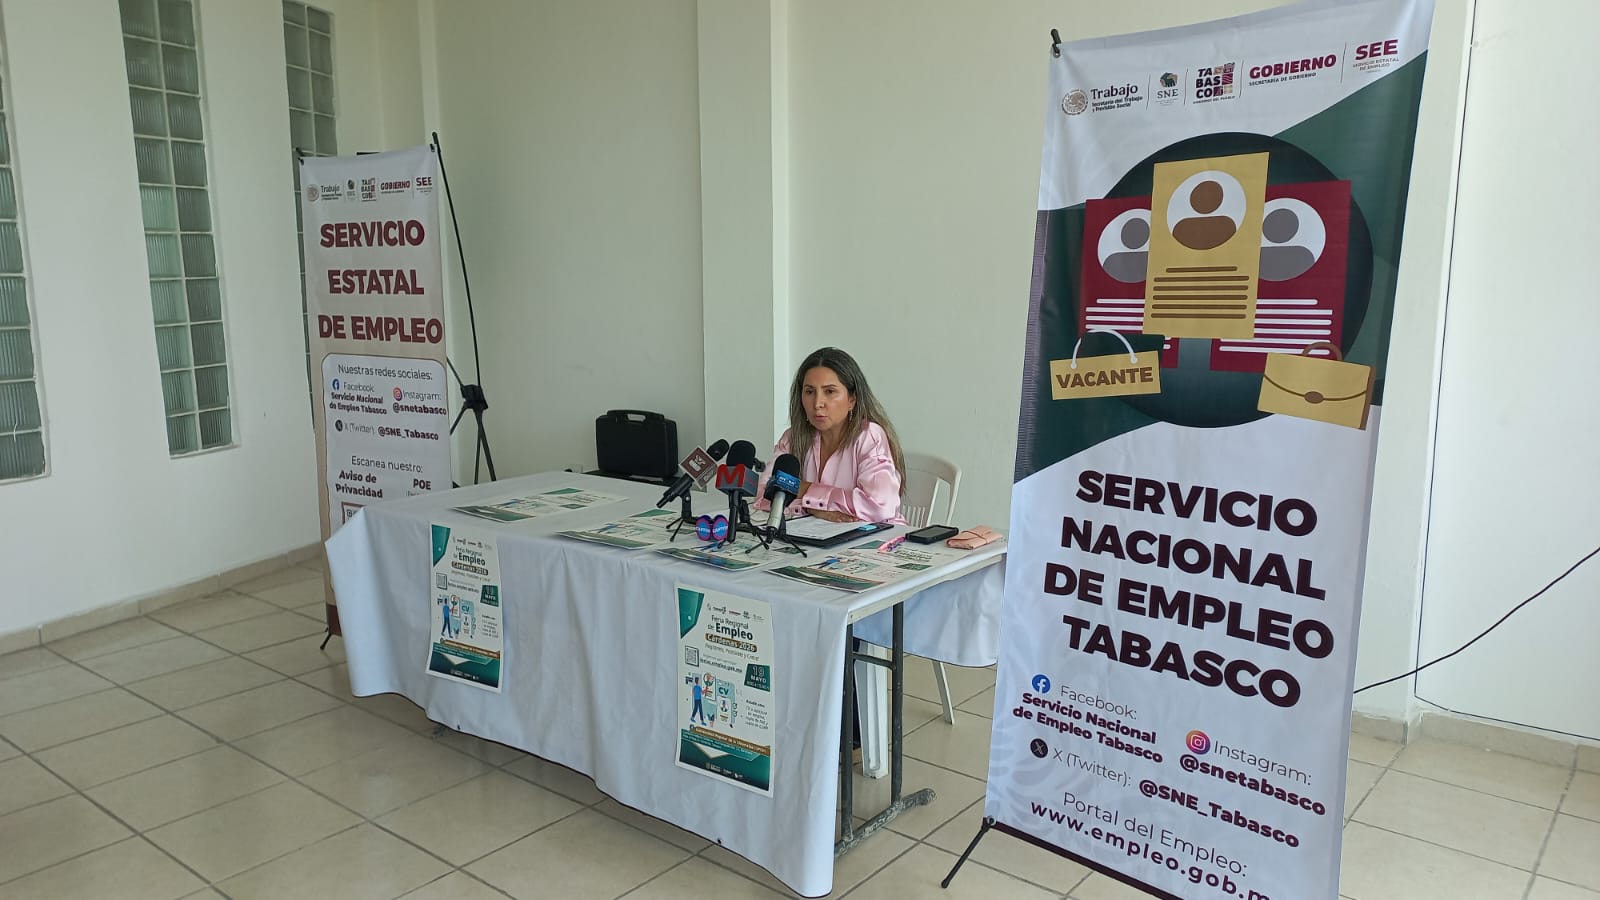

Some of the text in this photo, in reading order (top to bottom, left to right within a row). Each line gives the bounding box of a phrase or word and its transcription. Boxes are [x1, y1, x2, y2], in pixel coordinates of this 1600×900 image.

[1355, 39, 1398, 60] SEE
[1198, 67, 1212, 77] TA
[1249, 54, 1337, 79] GOBIERNO
[1289, 72, 1317, 80] GOBIERNO
[1090, 83, 1138, 100] Trabajo
[1196, 75, 1221, 88] BAS
[1157, 89, 1178, 99] SNE
[1196, 88, 1213, 98] CO
[380, 180, 411, 191] GOBIERNO
[416, 176, 432, 187] SEE
[320, 220, 425, 248] SERVICIO
[327, 269, 425, 295] ESTATAL
[318, 314, 443, 344] DE EMPLEO
[338, 364, 433, 380] Nuestras redes sociales:
[1056, 366, 1153, 389] VACANTE
[329, 402, 388, 415] de Empleo Tabasco
[331, 391, 447, 415] Servicio Nacional @snetabasco
[377, 426, 439, 441] @SNE_Tabasco
[351, 456, 423, 474] Escanea nuestro:
[716, 463, 746, 488] M
[339, 470, 377, 483] Aviso de
[413, 478, 432, 490] POE
[335, 483, 383, 498] Privacidad
[1075, 470, 1317, 537] SERVICIO
[459, 552, 486, 567] Empleo
[1060, 516, 1326, 601] NACIONAL
[1043, 562, 1334, 659] DE EMPLEO
[715, 622, 753, 641] Empleo
[1063, 614, 1301, 708] TABASCO
[751, 674, 767, 684] MAYO
[718, 687, 729, 696] CV
[1060, 685, 1137, 720] Facebook:
[1022, 692, 1157, 744] Servicio Nacional
[1013, 706, 1163, 764] de Empleo Tabasco
[1052, 748, 1132, 787] X (Twitter):
[1214, 741, 1312, 786] Instagram:
[1179, 754, 1326, 816] @snetabasco
[1139, 779, 1300, 848] @SNE_Tabasco
[1063, 791, 1247, 877] Portal del Empleo:
